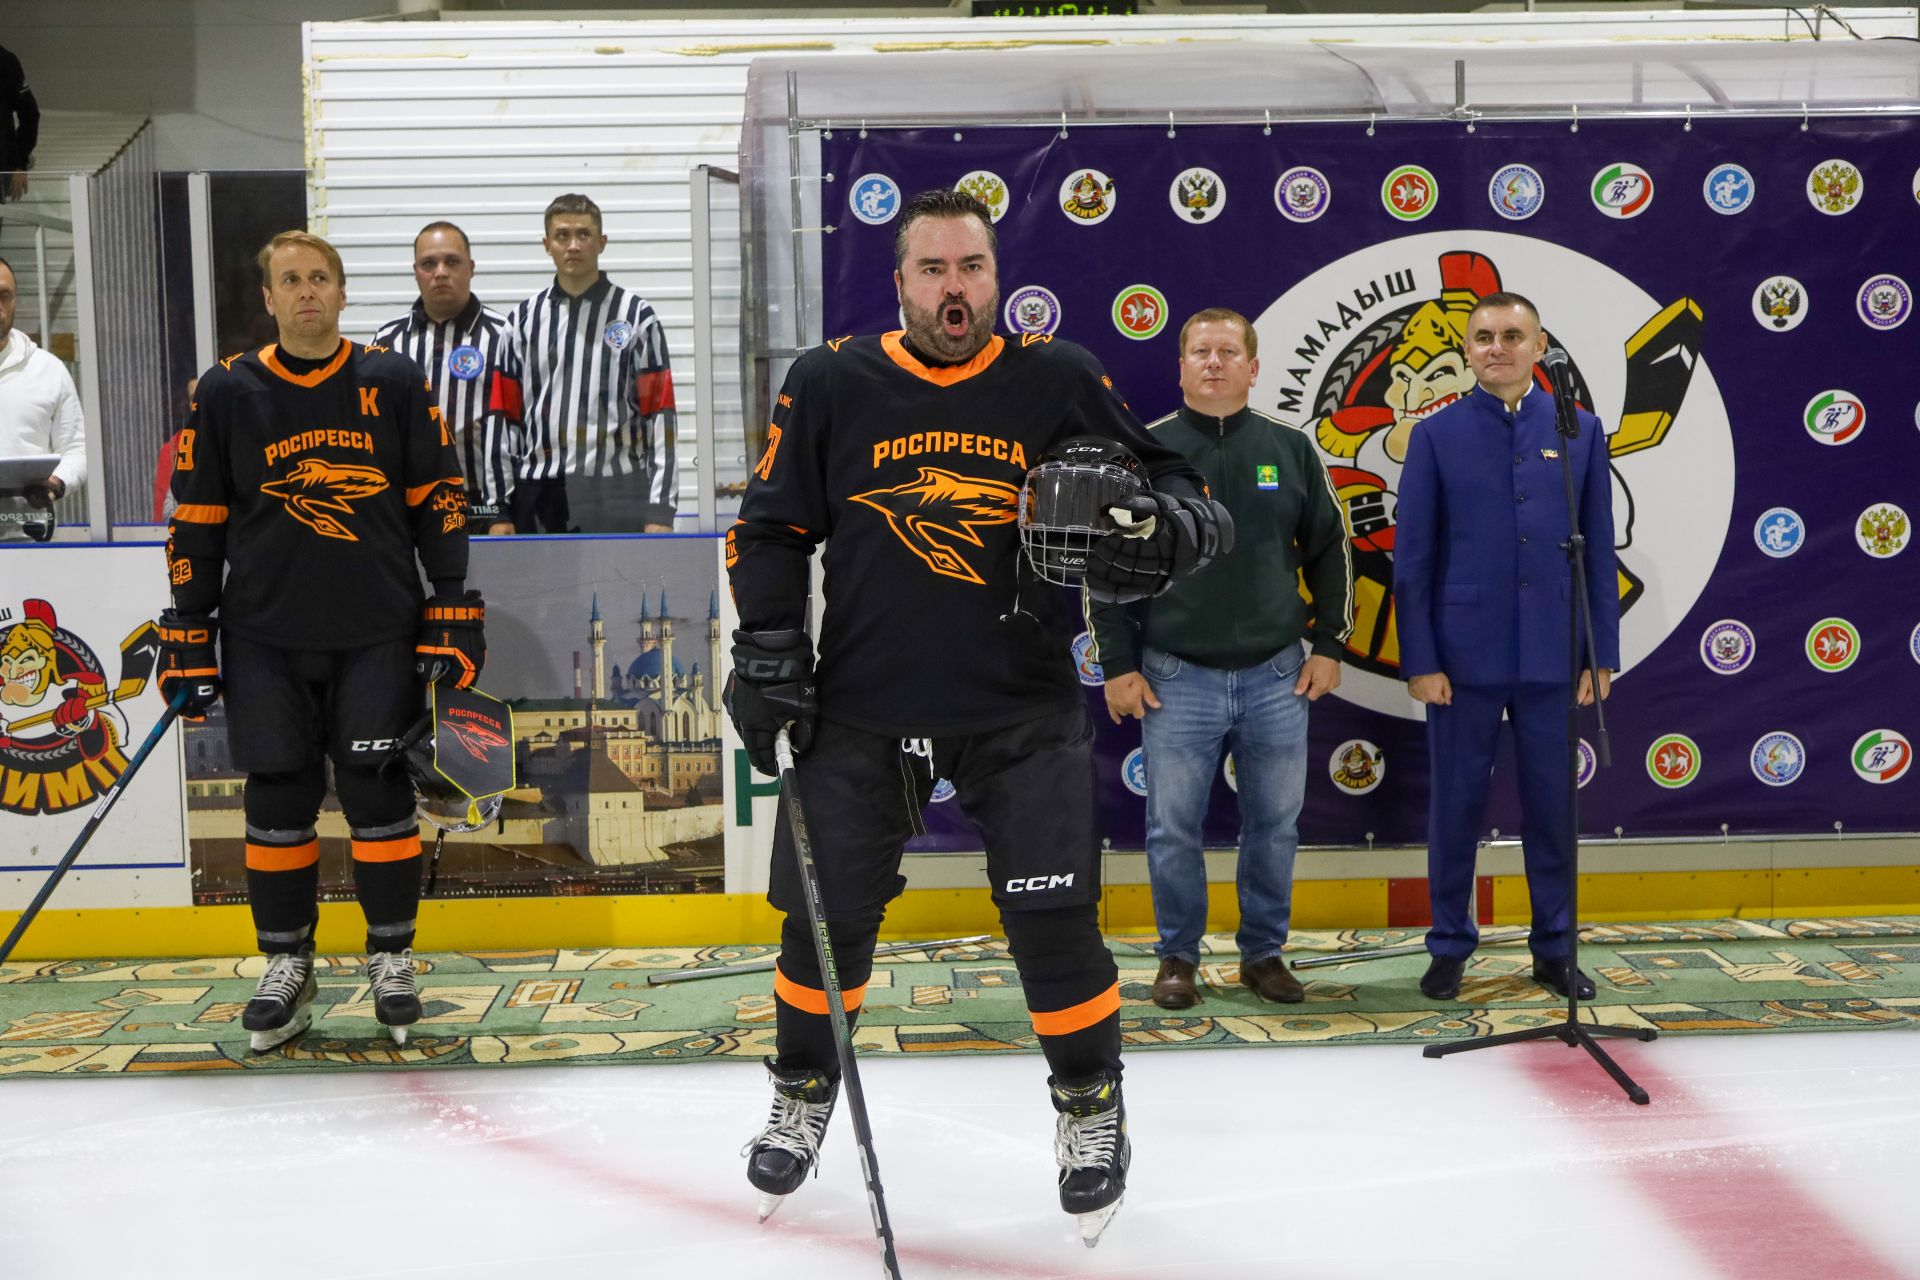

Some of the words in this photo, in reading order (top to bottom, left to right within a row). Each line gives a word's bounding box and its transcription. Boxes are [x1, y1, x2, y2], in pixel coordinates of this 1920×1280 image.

[1277, 268, 1417, 413] МАМАДЫШ
[264, 429, 375, 467] РОСПРЕССА
[873, 431, 1028, 470] РОСПРЕССА
[1066, 446, 1104, 454] CCM
[174, 562, 190, 579] 92
[449, 707, 502, 730] РОСПРЕССА
[351, 737, 401, 752] CC
[1005, 872, 1075, 893] CCM
